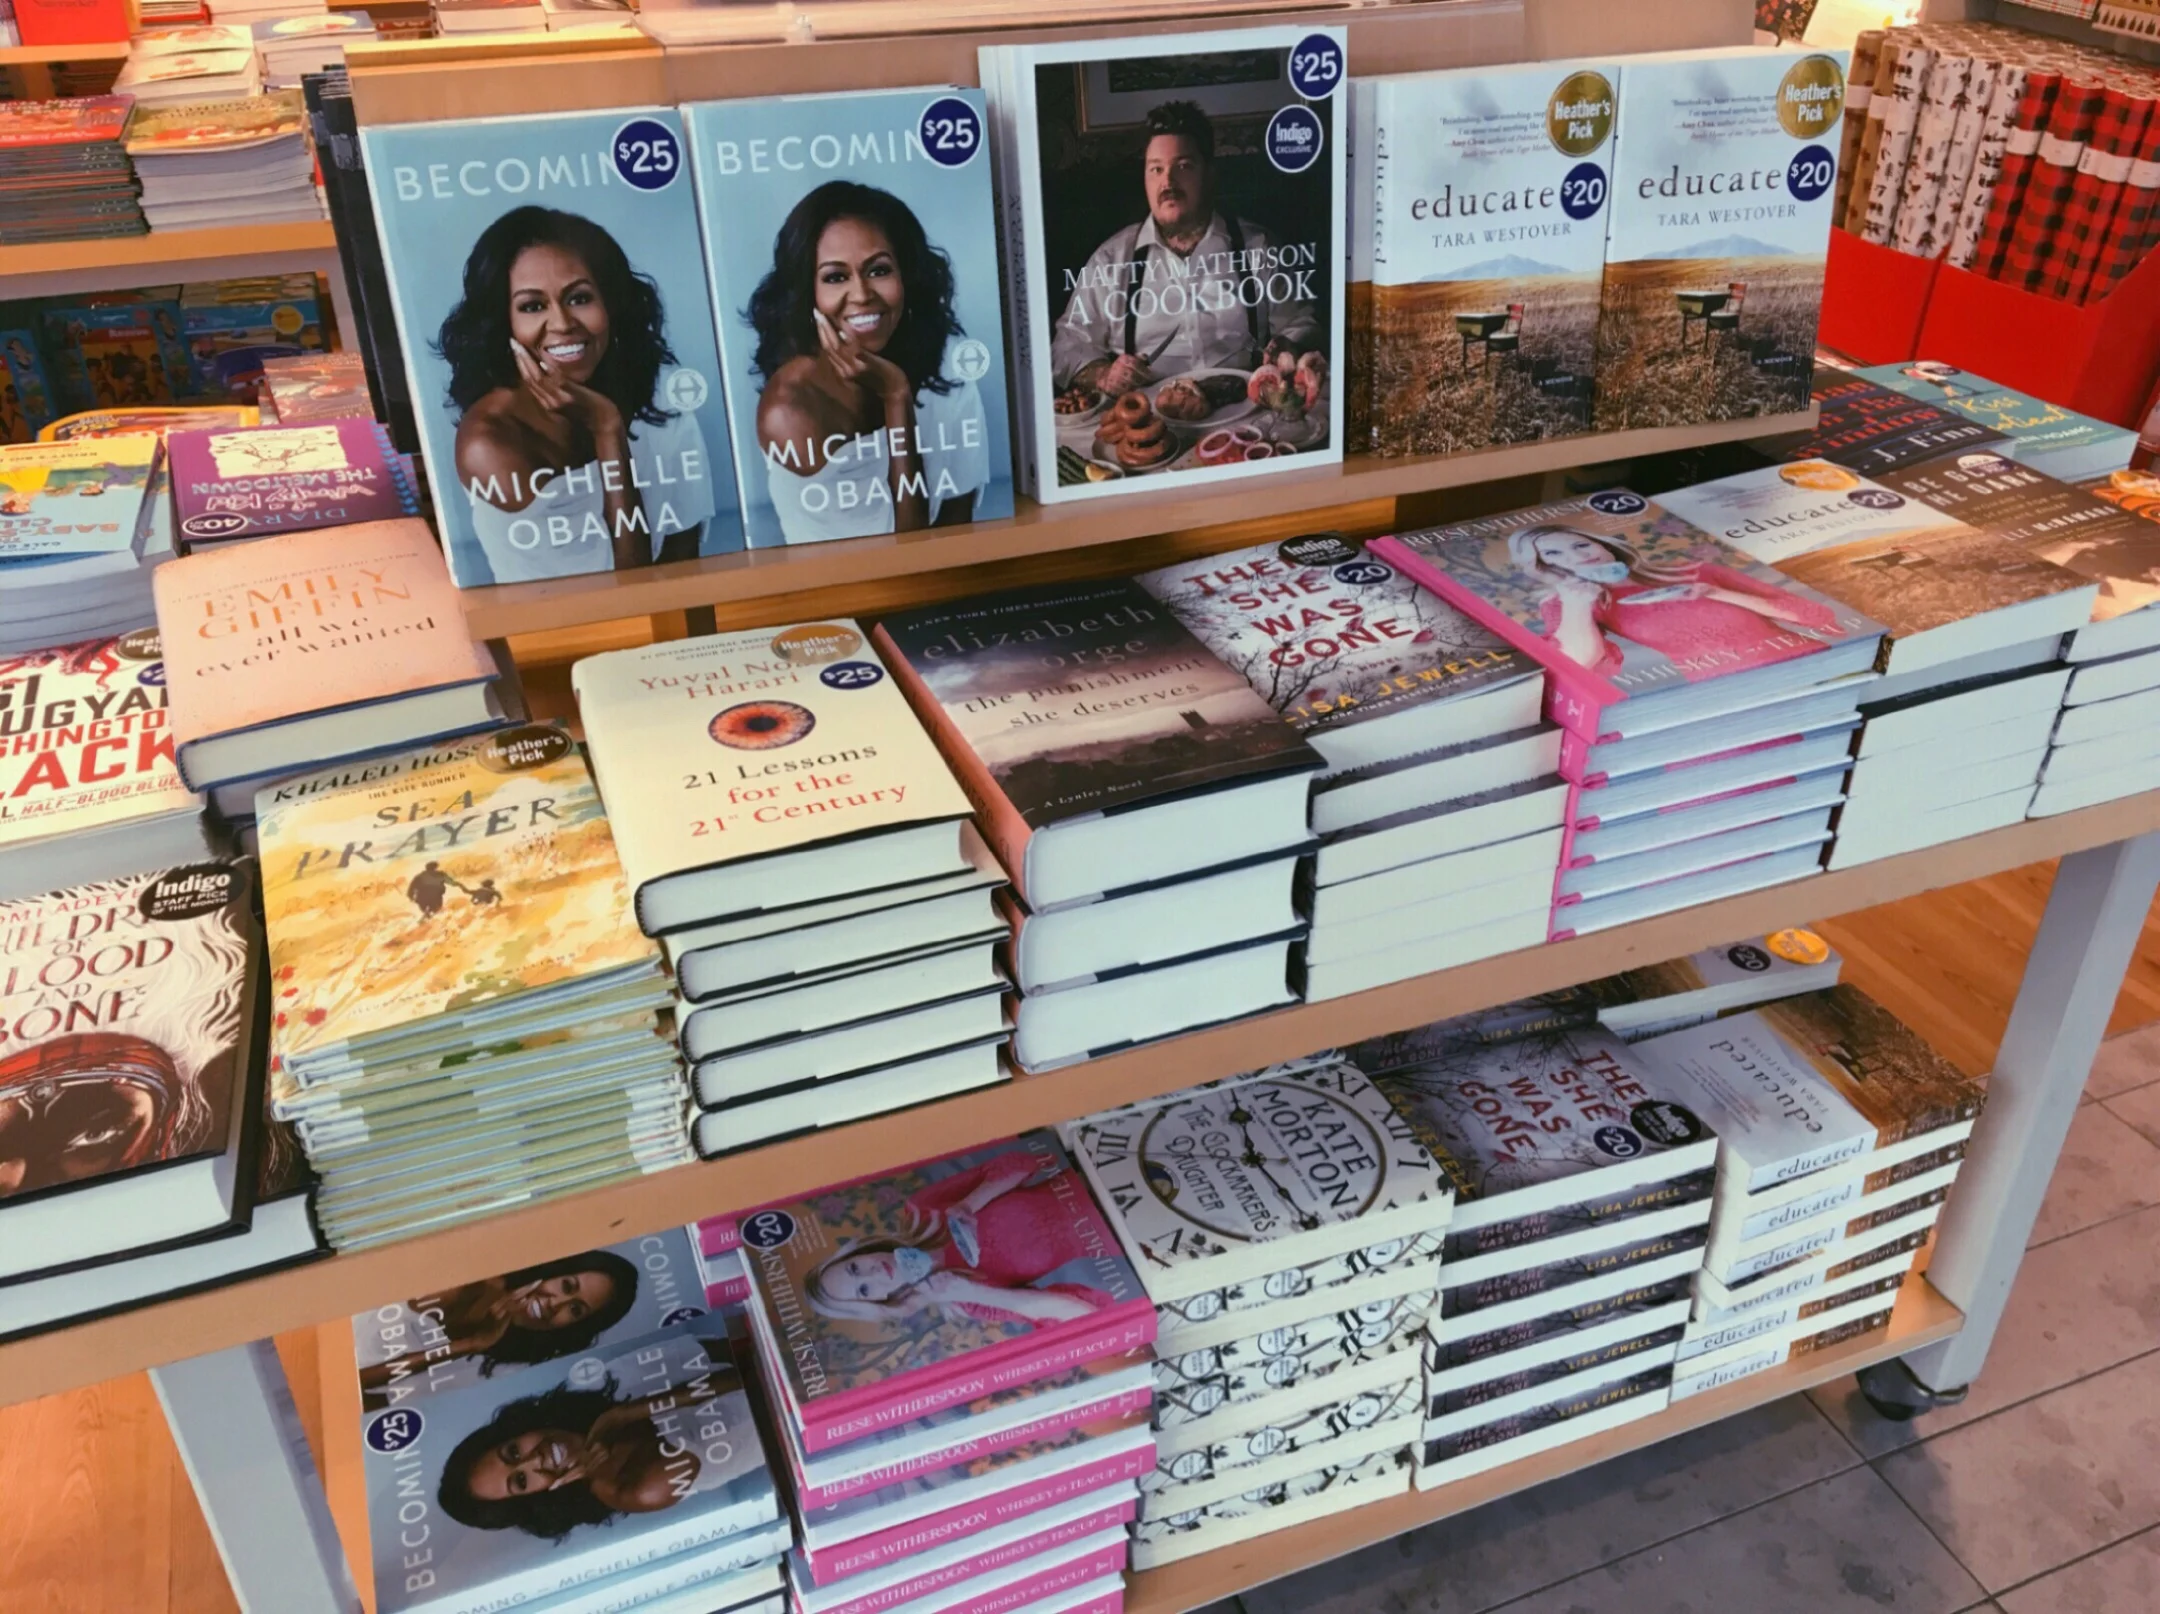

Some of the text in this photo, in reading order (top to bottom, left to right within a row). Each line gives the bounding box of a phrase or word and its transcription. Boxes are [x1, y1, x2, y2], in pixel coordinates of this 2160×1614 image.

[1294, 50, 1337, 83] $25
[1553, 100, 1612, 120] Heather's
[1785, 82, 1842, 103] Heather's
[1567, 121, 1594, 140] Pick
[1797, 104, 1824, 122] Pick
[925, 118, 974, 150] $25
[1275, 123, 1313, 144] Indigo
[618, 139, 674, 173] $25
[717, 130, 929, 175] BECOMIN
[393, 151, 618, 201] BECOMIN
[1564, 178, 1604, 208] $20
[1638, 165, 1782, 200] educate
[1790, 161, 1832, 191] $20
[1411, 184, 1555, 221] educate
[1657, 203, 1797, 228] TARA WESTOVER
[1432, 222, 1572, 249] TARA WESTOVER
[1063, 242, 1318, 291] MATTY MATHESON
[1065, 269, 1318, 328] A COOKBOOK
[764, 418, 981, 469] MICHELLE
[1907, 425, 1983, 448] Finn
[191, 467, 378, 495] THE MELTDOWN
[468, 449, 703, 507] MICHELLE
[801, 468, 959, 513] OBAMA
[1966, 471, 2044, 495] DARK
[247, 507, 347, 527] DIARY
[1593, 493, 1641, 512] $20
[1725, 498, 1857, 540] educate
[506, 502, 682, 551] OBAMA
[1403, 524, 1476, 547] REESE
[1474, 498, 1588, 534] WITHERSP
[1767, 509, 1894, 545] TARA WESTOVER
[1283, 538, 1342, 556] Indigo
[1337, 565, 1388, 582] $20
[204, 567, 388, 618] EMILY
[1227, 576, 1331, 611] SHE
[198, 583, 412, 640] GIFFIN
[923, 616, 951, 627] NEW
[956, 610, 988, 620] YORK
[993, 603, 1031, 614] TIMES
[1252, 598, 1364, 636] WAS
[196, 649, 281, 678] ever
[297, 616, 437, 653] wanted
[256, 616, 370, 648] all we
[655, 641, 737, 659] INTERNATIONAL
[779, 632, 855, 652] Heather's
[923, 605, 1156, 660] elizabeth
[1267, 617, 1414, 668] GONE
[803, 644, 838, 658] Pick
[1612, 647, 1742, 687] WHISKEY
[639, 665, 732, 691] Yuval
[686, 673, 801, 699] Harari
[824, 666, 878, 685] $25
[964, 656, 1206, 714] the punishment
[1377, 650, 1513, 697] JEWELL
[1010, 682, 1201, 730] she deserves
[1324, 710, 1354, 722] YORK
[1358, 701, 1392, 714] TIMES
[1473, 662, 1517, 679] AUTHOR
[486, 734, 564, 760] Heather's
[508, 750, 545, 766] Pick
[273, 764, 400, 804] KHALED
[368, 791, 389, 800] THE
[421, 772, 467, 789] RUNNER
[683, 745, 878, 791] 21 Lessons
[728, 770, 855, 805] for the
[752, 783, 908, 824] Century
[1107, 780, 1143, 794] Novel
[372, 789, 476, 830] SEA
[293, 796, 563, 882] PRAYER
[152, 889, 229, 909] STAFF PICK
[154, 873, 231, 899] Indigo
[151, 897, 229, 916] OF THE MONTH
[52, 937, 89, 956] OF
[33, 981, 92, 1007] AND
[1519, 1016, 1568, 1034] JEWELL
[1550, 1065, 1611, 1122] SHE
[1709, 1039, 1824, 1135] educated
[1457, 1080, 1537, 1154] GONE
[1507, 1076, 1572, 1135] WAS
[1253, 1089, 1359, 1210] MORTON
[1302, 1100, 1376, 1174] KATE
[1602, 1127, 1635, 1156] $20
[1164, 1134, 1225, 1213] DAUGHTER
[1179, 1104, 1215, 1132] THE
[1200, 1130, 1280, 1233] CLOCKMAKER'S
[1777, 1138, 1865, 1179] educated
[1590, 1187, 1681, 1218] LISA JEWELL
[1768, 1185, 1852, 1228] educated
[755, 1212, 784, 1246] $20
[1512, 1224, 1549, 1241] GONE
[1585, 1239, 1675, 1272] LISA JEWELL
[1753, 1228, 1836, 1272] educated
[1509, 1278, 1546, 1297] GONE
[1573, 1286, 1659, 1320] LISA JEWELL
[1704, 1311, 1787, 1350] educated
[377, 1303, 416, 1404] OBAMA
[792, 1337, 830, 1399] REESE
[1567, 1337, 1653, 1371] LISA JEWELL
[825, 1336, 1118, 1441] REESE WITHERSPOON WHISKEY TEACUP
[1696, 1352, 1778, 1392] educated
[682, 1352, 733, 1465] OBAMA
[1559, 1383, 1642, 1418] LISA JEWELL
[383, 1412, 410, 1450] $25
[637, 1346, 699, 1501] MICHELLE
[822, 1400, 1111, 1498] REESE WITHERSPOON WHISKEY TEACUP
[834, 1468, 1118, 1574] REESE WITHERSPOON WHISKEY TEACUP
[558, 1523, 741, 1588] MICHELLE OBAMA
[685, 1555, 757, 1581] OBAMA
[867, 1518, 1098, 1609] WITHERSPOON WHISKEY TEACUP
[972, 1568, 1089, 1614] WHISKEY TEACUP
